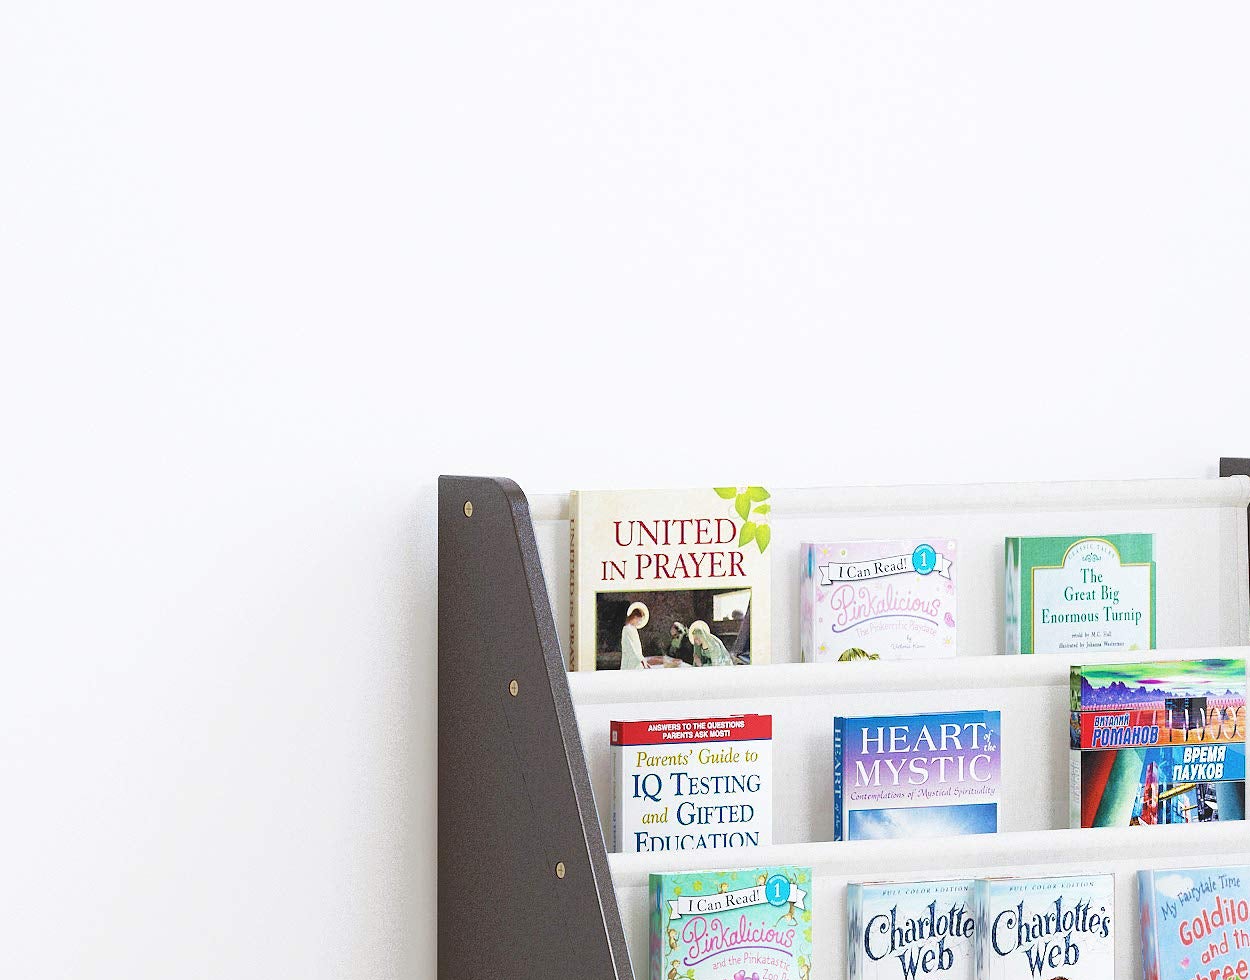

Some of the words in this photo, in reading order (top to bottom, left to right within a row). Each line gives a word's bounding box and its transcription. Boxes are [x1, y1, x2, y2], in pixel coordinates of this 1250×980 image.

[613, 518, 737, 547] UNITED
[600, 560, 627, 581] IN
[635, 551, 747, 580] PRAYER
[838, 566, 844, 579] I
[846, 565, 871, 579] Can
[873, 557, 908, 575] Read!
[920, 551, 927, 567] 1
[1080, 568, 1103, 584] The
[830, 583, 941, 626] Pinkalicious
[1064, 586, 1096, 601] Great
[1101, 585, 1120, 605] Big
[1042, 608, 1099, 624] Enormous
[1103, 606, 1142, 625] Turnip
[648, 723, 681, 732] ANSWERS
[682, 723, 692, 731] TO
[693, 722, 707, 730] THE
[707, 720, 745, 730] QUESTIONS
[1094, 713, 1130, 727] ВИТАЛИЙ
[662, 731, 693, 740] PARENTS
[694, 730, 708, 739] ASK
[861, 722, 987, 754] HEART
[983, 729, 994, 743] of
[1092, 726, 1160, 747] РОМАНОВ
[698, 747, 740, 764] Guide
[745, 749, 758, 763] to
[983, 742, 997, 752] the
[1183, 745, 1227, 763] ВРЕМЯ
[854, 754, 992, 788] MYSTIC
[1172, 763, 1225, 781] ПАУКОВ
[632, 773, 662, 802] IQ
[670, 772, 761, 796] TESTING
[642, 807, 668, 824] and
[676, 801, 754, 826] GIFTED
[634, 831, 760, 853] EDUCATION
[688, 900, 694, 912] I
[697, 898, 722, 911] Can
[725, 889, 760, 907] Read!
[774, 883, 781, 898] 1
[1161, 903, 1177, 921] My
[1177, 877, 1217, 906] Fairytale
[1218, 874, 1241, 889] Time
[682, 914, 796, 959] Pinkalicious
[864, 900, 975, 961] Charlotte
[1024, 931, 1080, 979] Web
[1201, 931, 1229, 965] and
[712, 957, 727, 970] and
[728, 955, 741, 966] the
[743, 951, 791, 971] Pinkatastic
